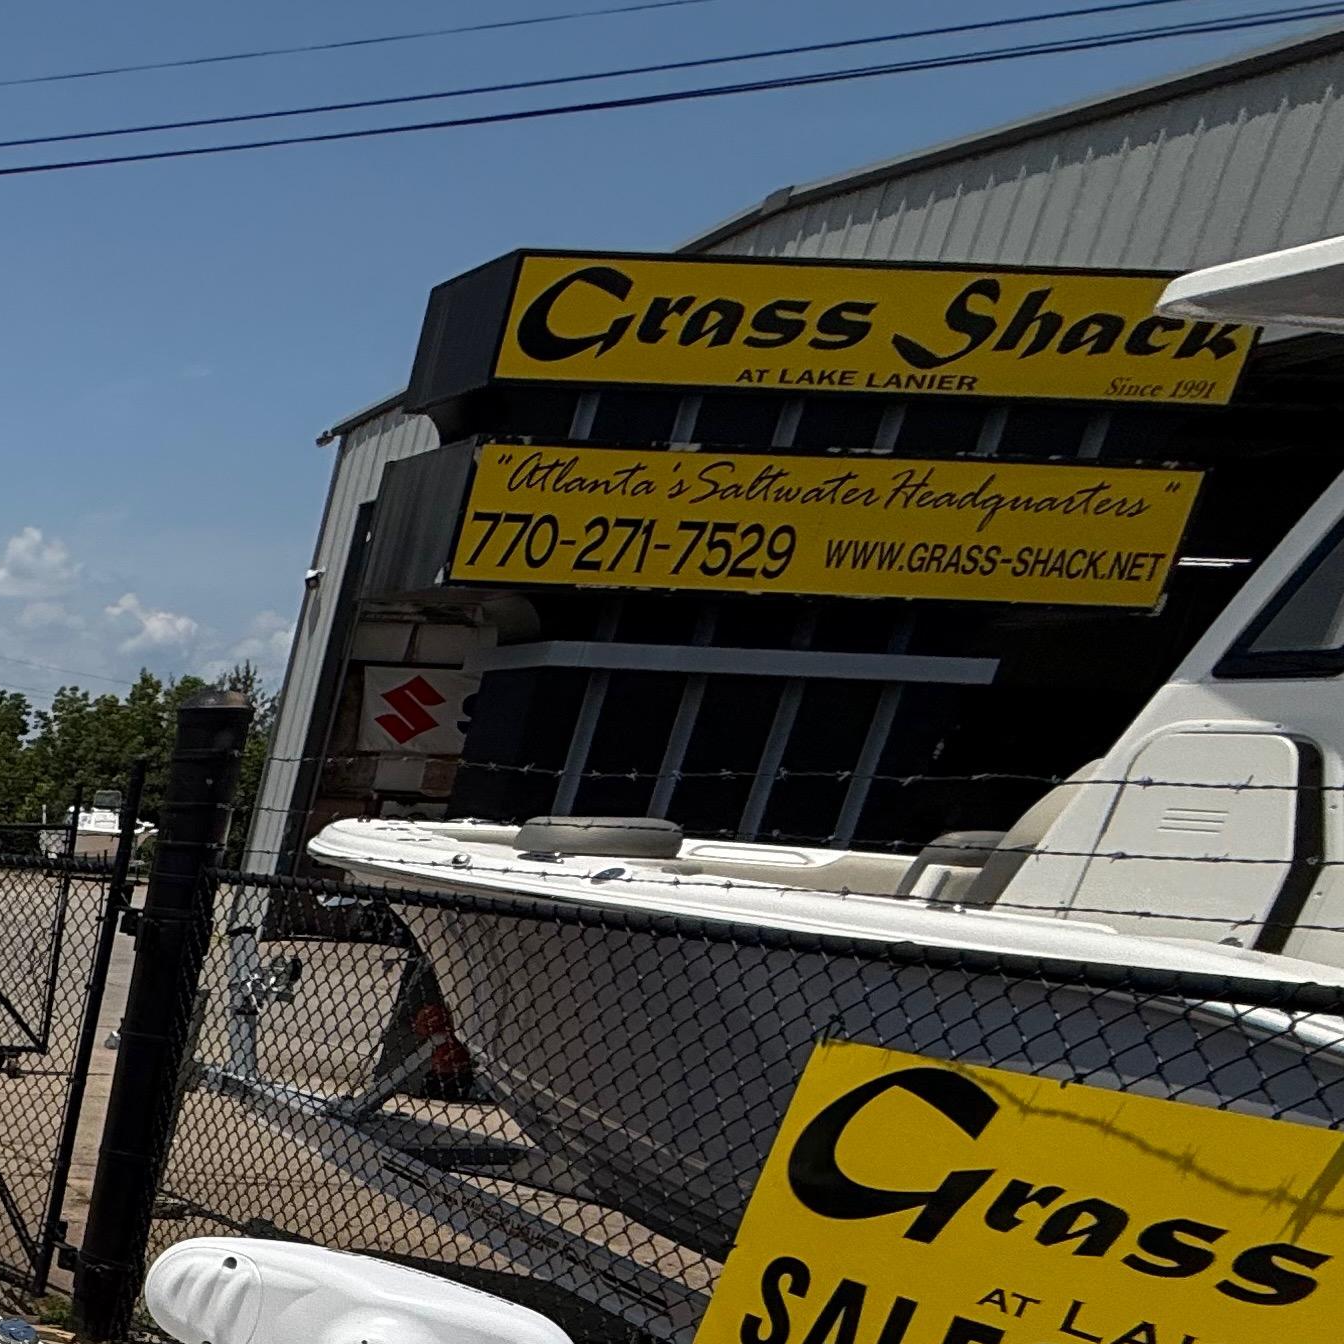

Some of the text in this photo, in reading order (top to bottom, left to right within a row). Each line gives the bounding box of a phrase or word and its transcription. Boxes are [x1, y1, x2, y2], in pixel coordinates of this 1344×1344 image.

[517, 266, 1243, 369] Grass Shack
[736, 368, 979, 391] AT LAKE LANIER
[1105, 377, 1217, 399] Since 1991
[688, 460, 879, 506] Saltwater
[465, 512, 797, 580] 770-271-7529
[825, 539, 1167, 582] WWW.GRASS-SHACK.NET
[788, 1067, 1333, 1306] Grass
[976, 1288, 1041, 1318] AT
